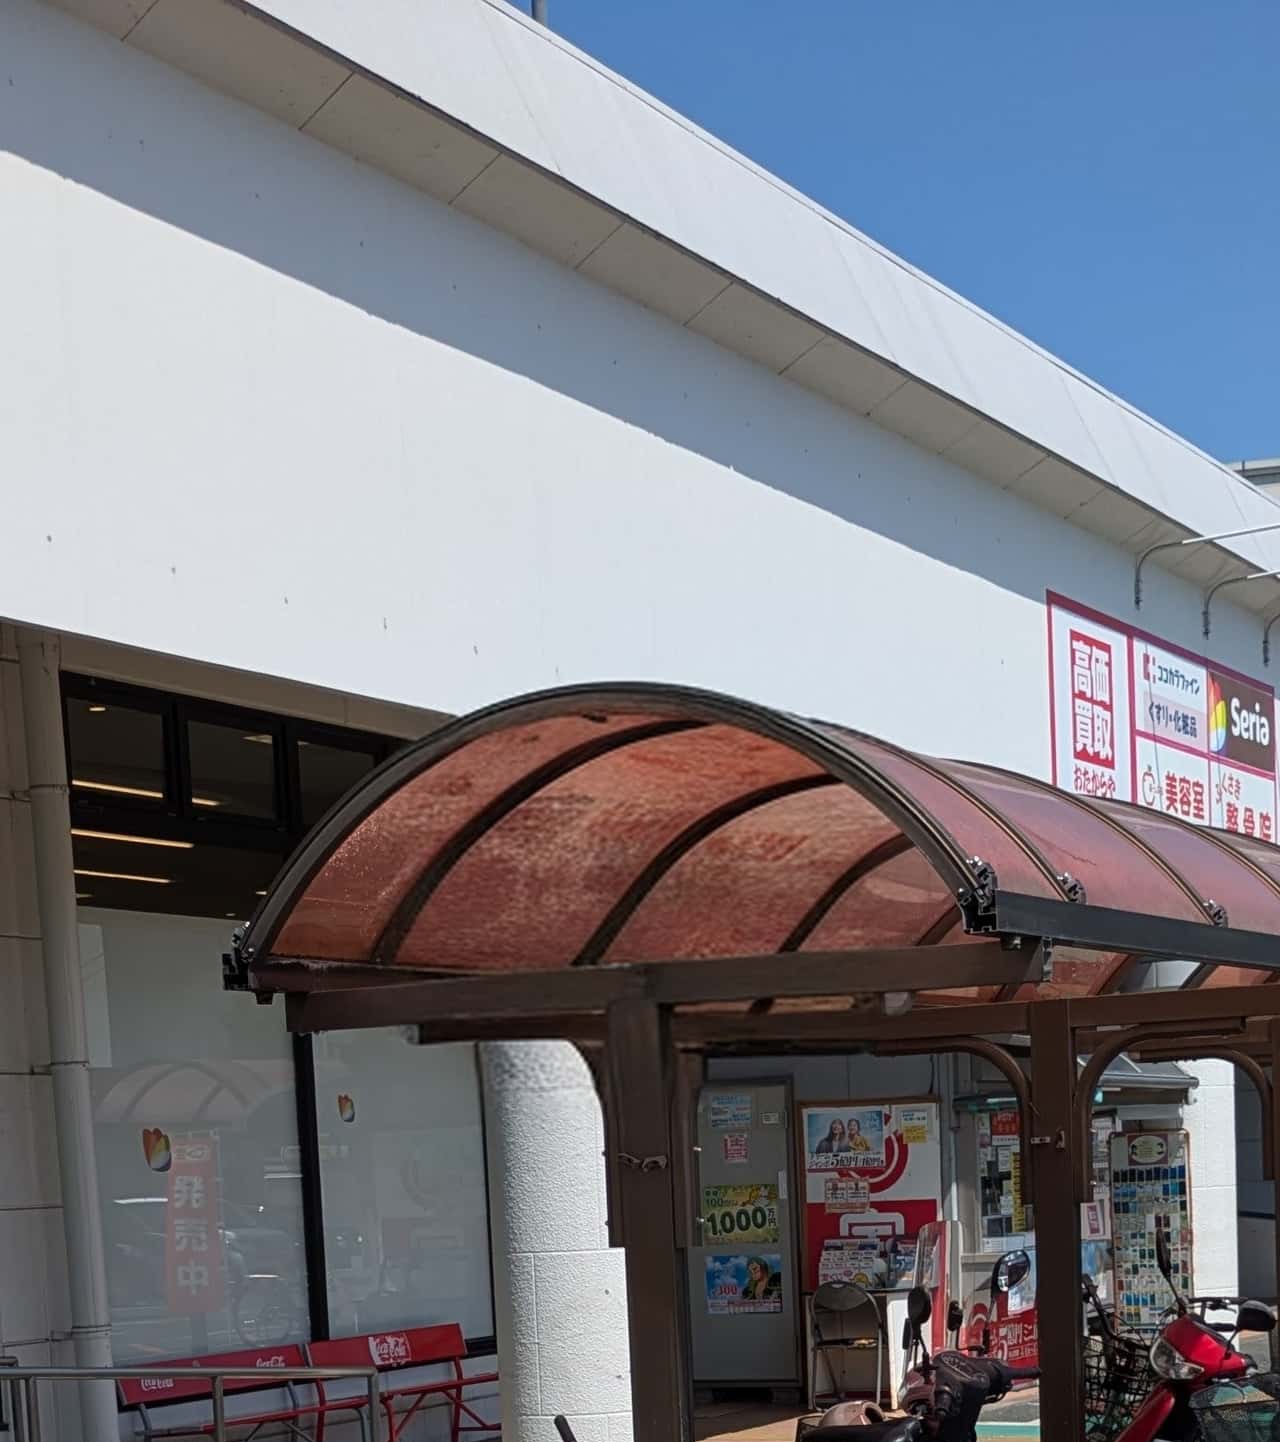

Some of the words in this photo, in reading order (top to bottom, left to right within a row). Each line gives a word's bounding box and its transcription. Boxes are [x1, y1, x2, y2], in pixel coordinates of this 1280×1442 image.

[1072, 639, 1111, 704] 高価
[1157, 664, 1201, 697] ココカラファイン
[1073, 699, 1114, 761] 買取
[1229, 695, 1271, 747] Seria
[1073, 765, 1117, 800] おたからや
[1164, 770, 1205, 820] 美容室
